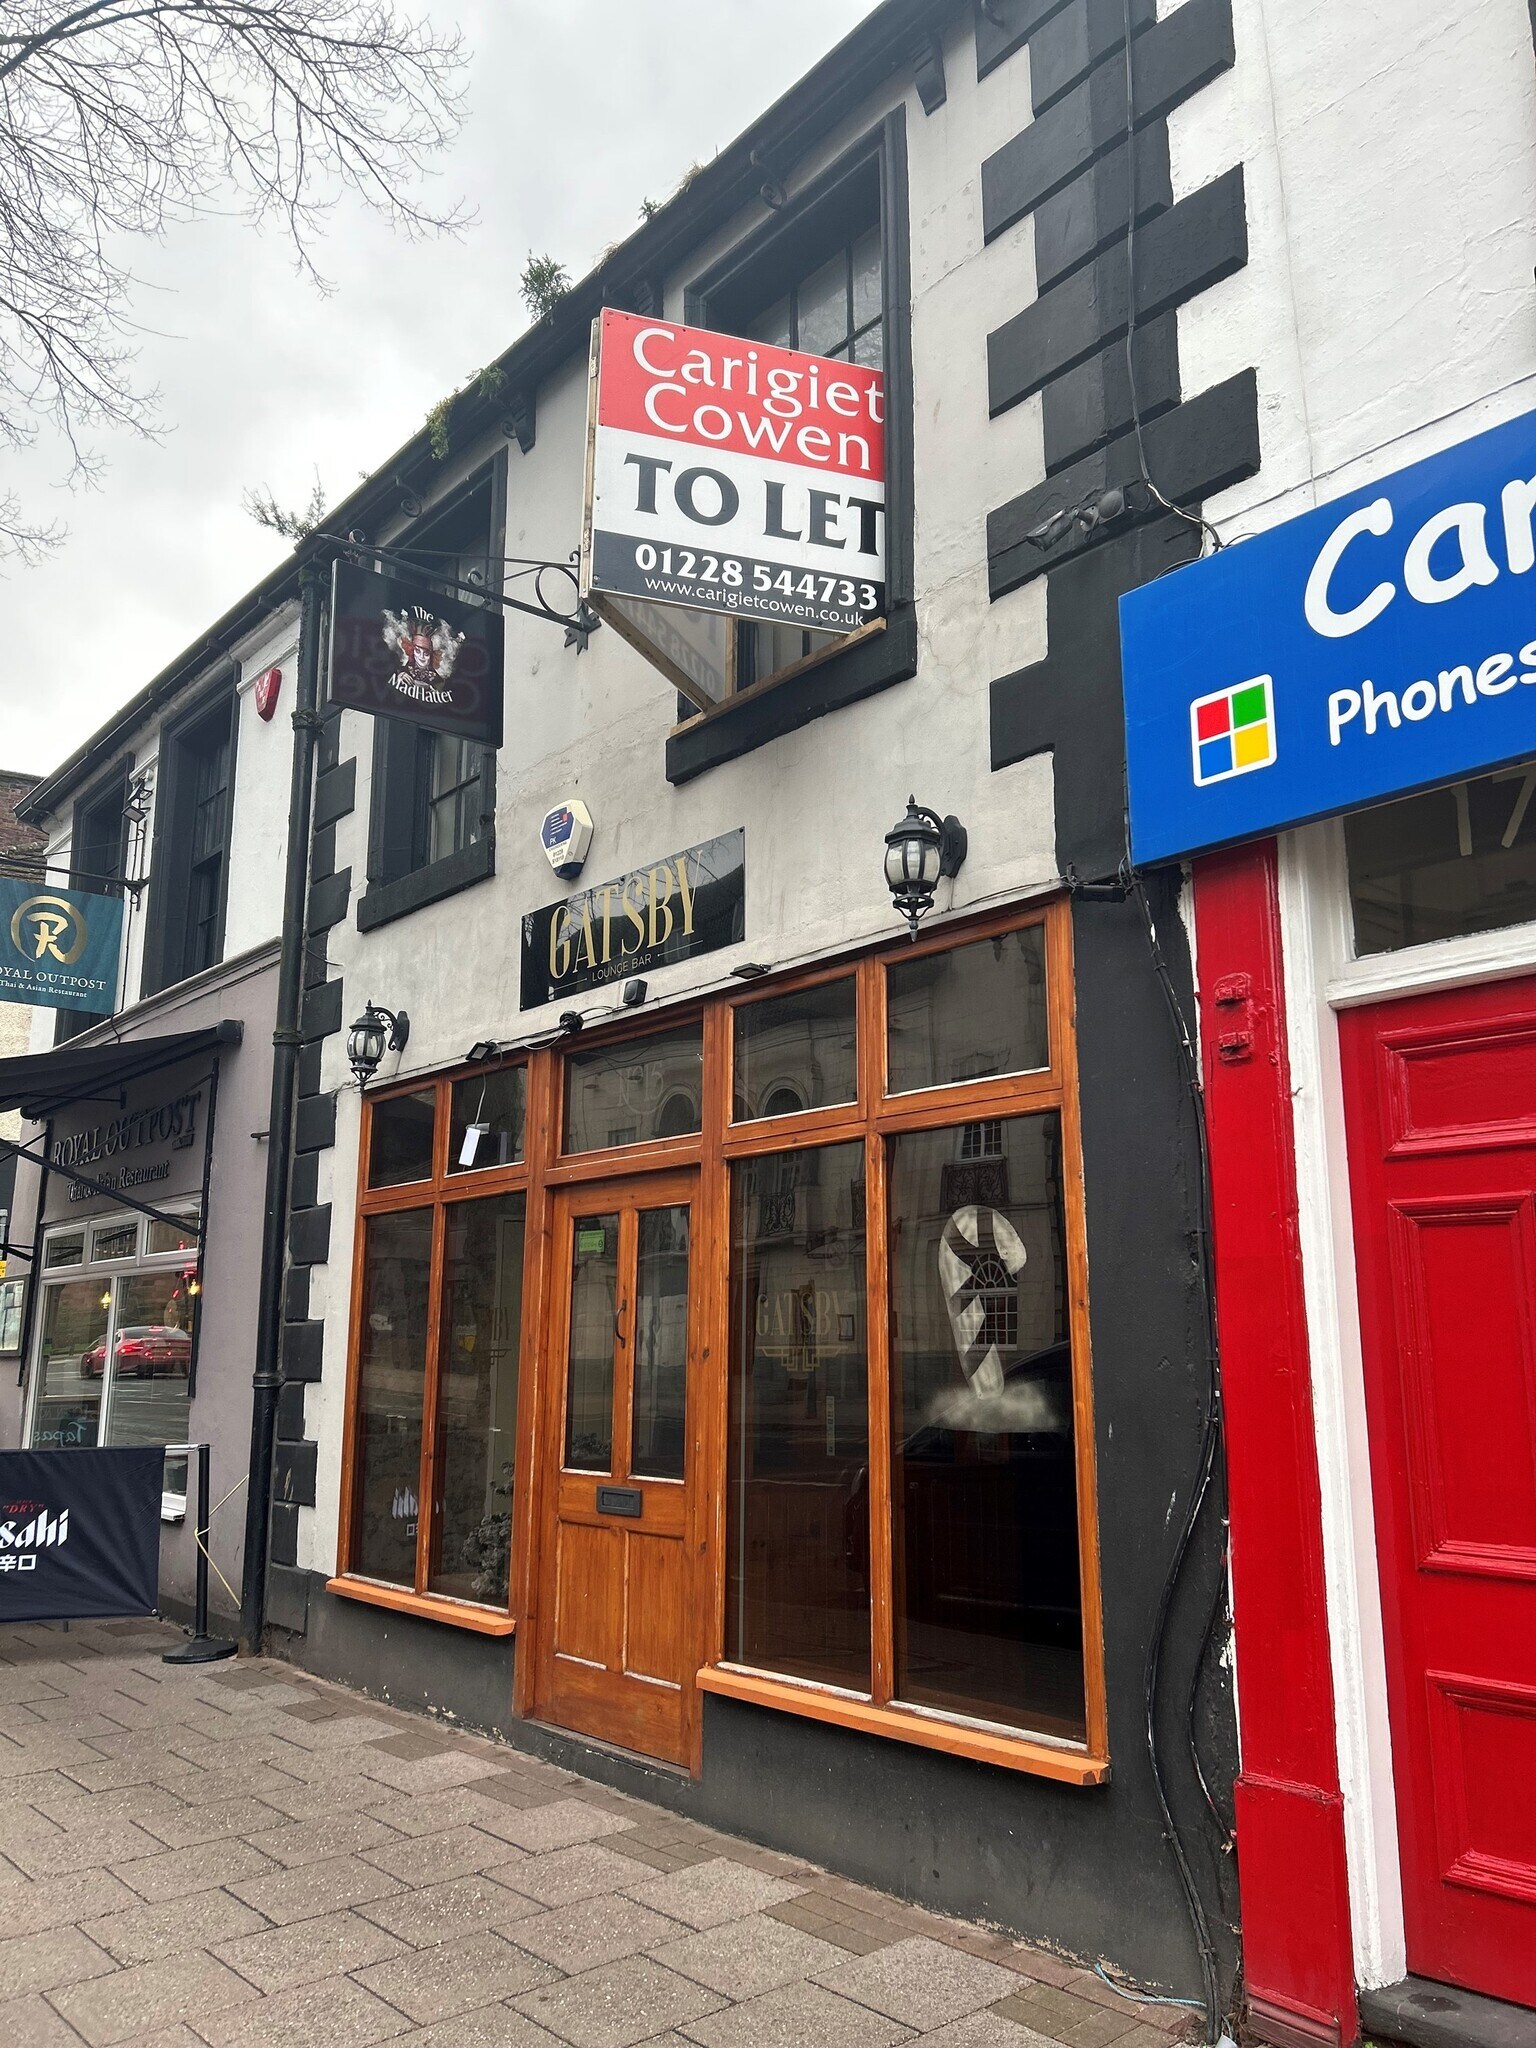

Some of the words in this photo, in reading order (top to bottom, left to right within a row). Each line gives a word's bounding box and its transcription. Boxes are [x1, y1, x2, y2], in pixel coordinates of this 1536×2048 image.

[632, 327, 885, 424] Carigiet
[644, 382, 871, 471] Cowen
[623, 452, 739, 526] TO
[762, 480, 885, 557] LET
[634, 543, 744, 587] 01228
[752, 565, 878, 611] 544733
[644, 576, 865, 626] www.carigietcowen.co.uk
[411, 605, 434, 622] The
[388, 672, 454, 704] MadHatter
[550, 849, 704, 979] GATSBY
[0, 979, 17, 989] Thai
[18, 982, 26, 990] &
[26, 983, 47, 993] Asian
[48, 986, 88, 999] Restaurant
[36, 971, 107, 991] OUTPOST
[592, 961, 629, 982] LOUNGE
[631, 953, 652, 969] BAR
[52, 1127, 102, 1173] ROYAL
[105, 1091, 201, 1156] OUTPOST
[118, 1160, 170, 1190] Restaurant
[756, 1290, 848, 1336] GATSBY
